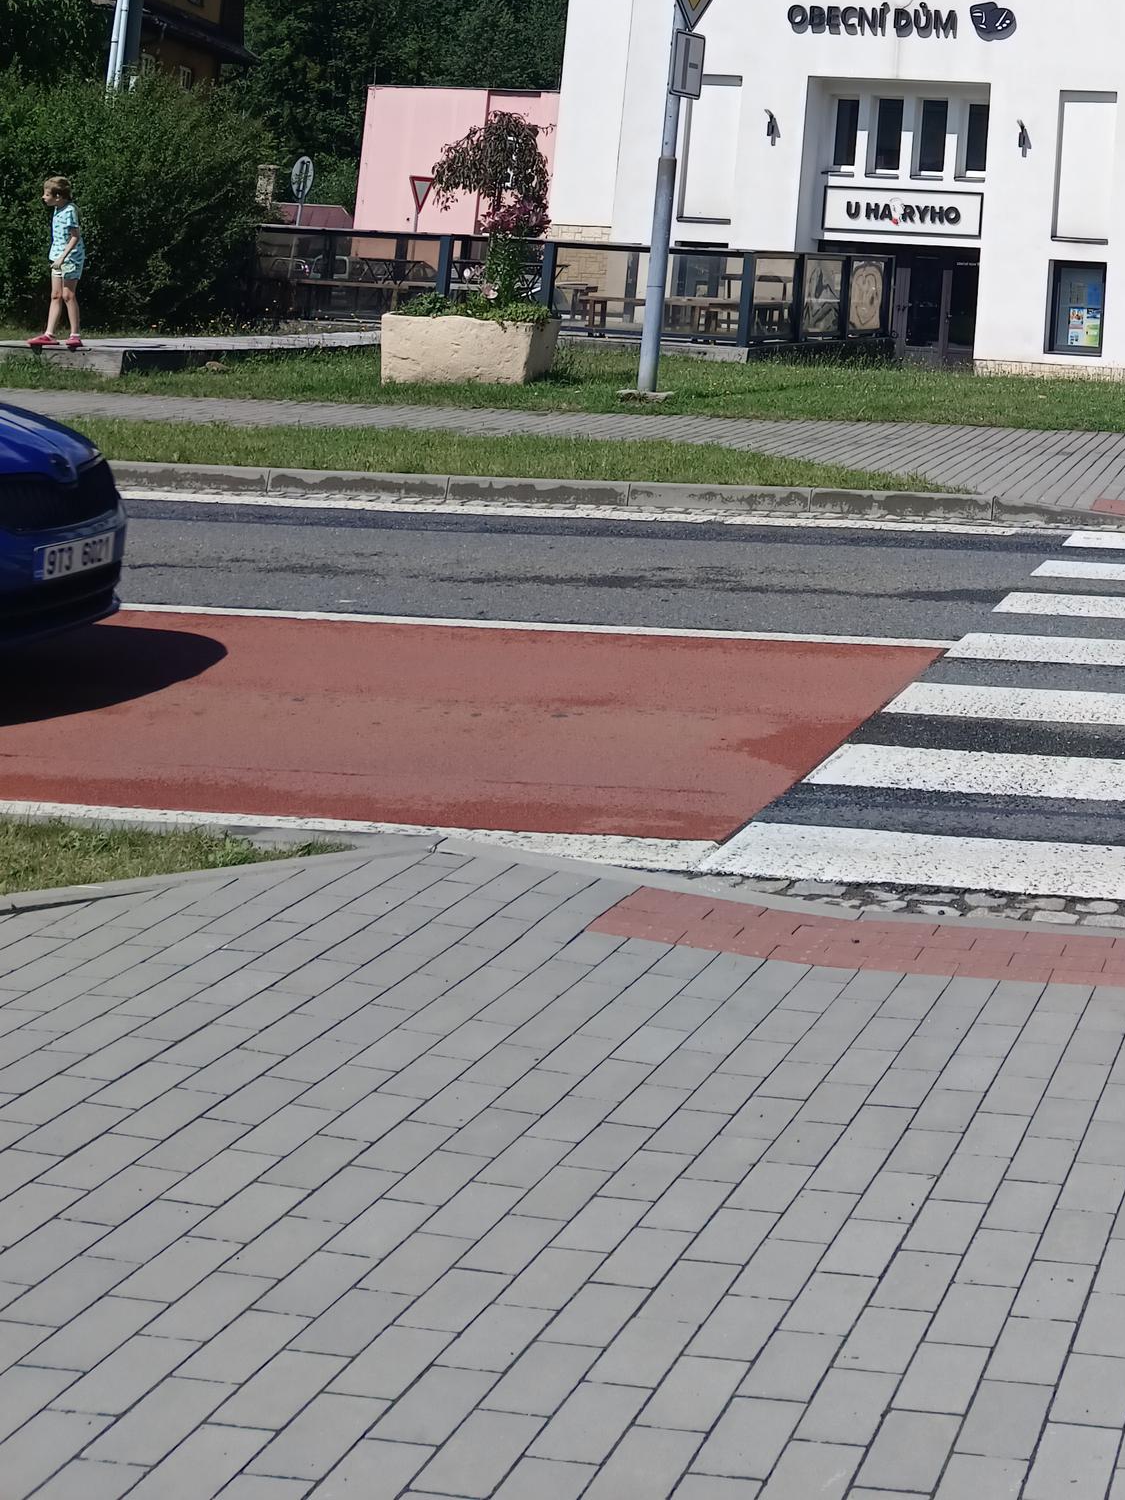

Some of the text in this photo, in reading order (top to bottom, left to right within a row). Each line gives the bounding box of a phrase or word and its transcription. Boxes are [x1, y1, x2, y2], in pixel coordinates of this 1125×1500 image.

[787, 1, 958, 39] OBECNÍ DŮM
[846, 200, 861, 220] U
